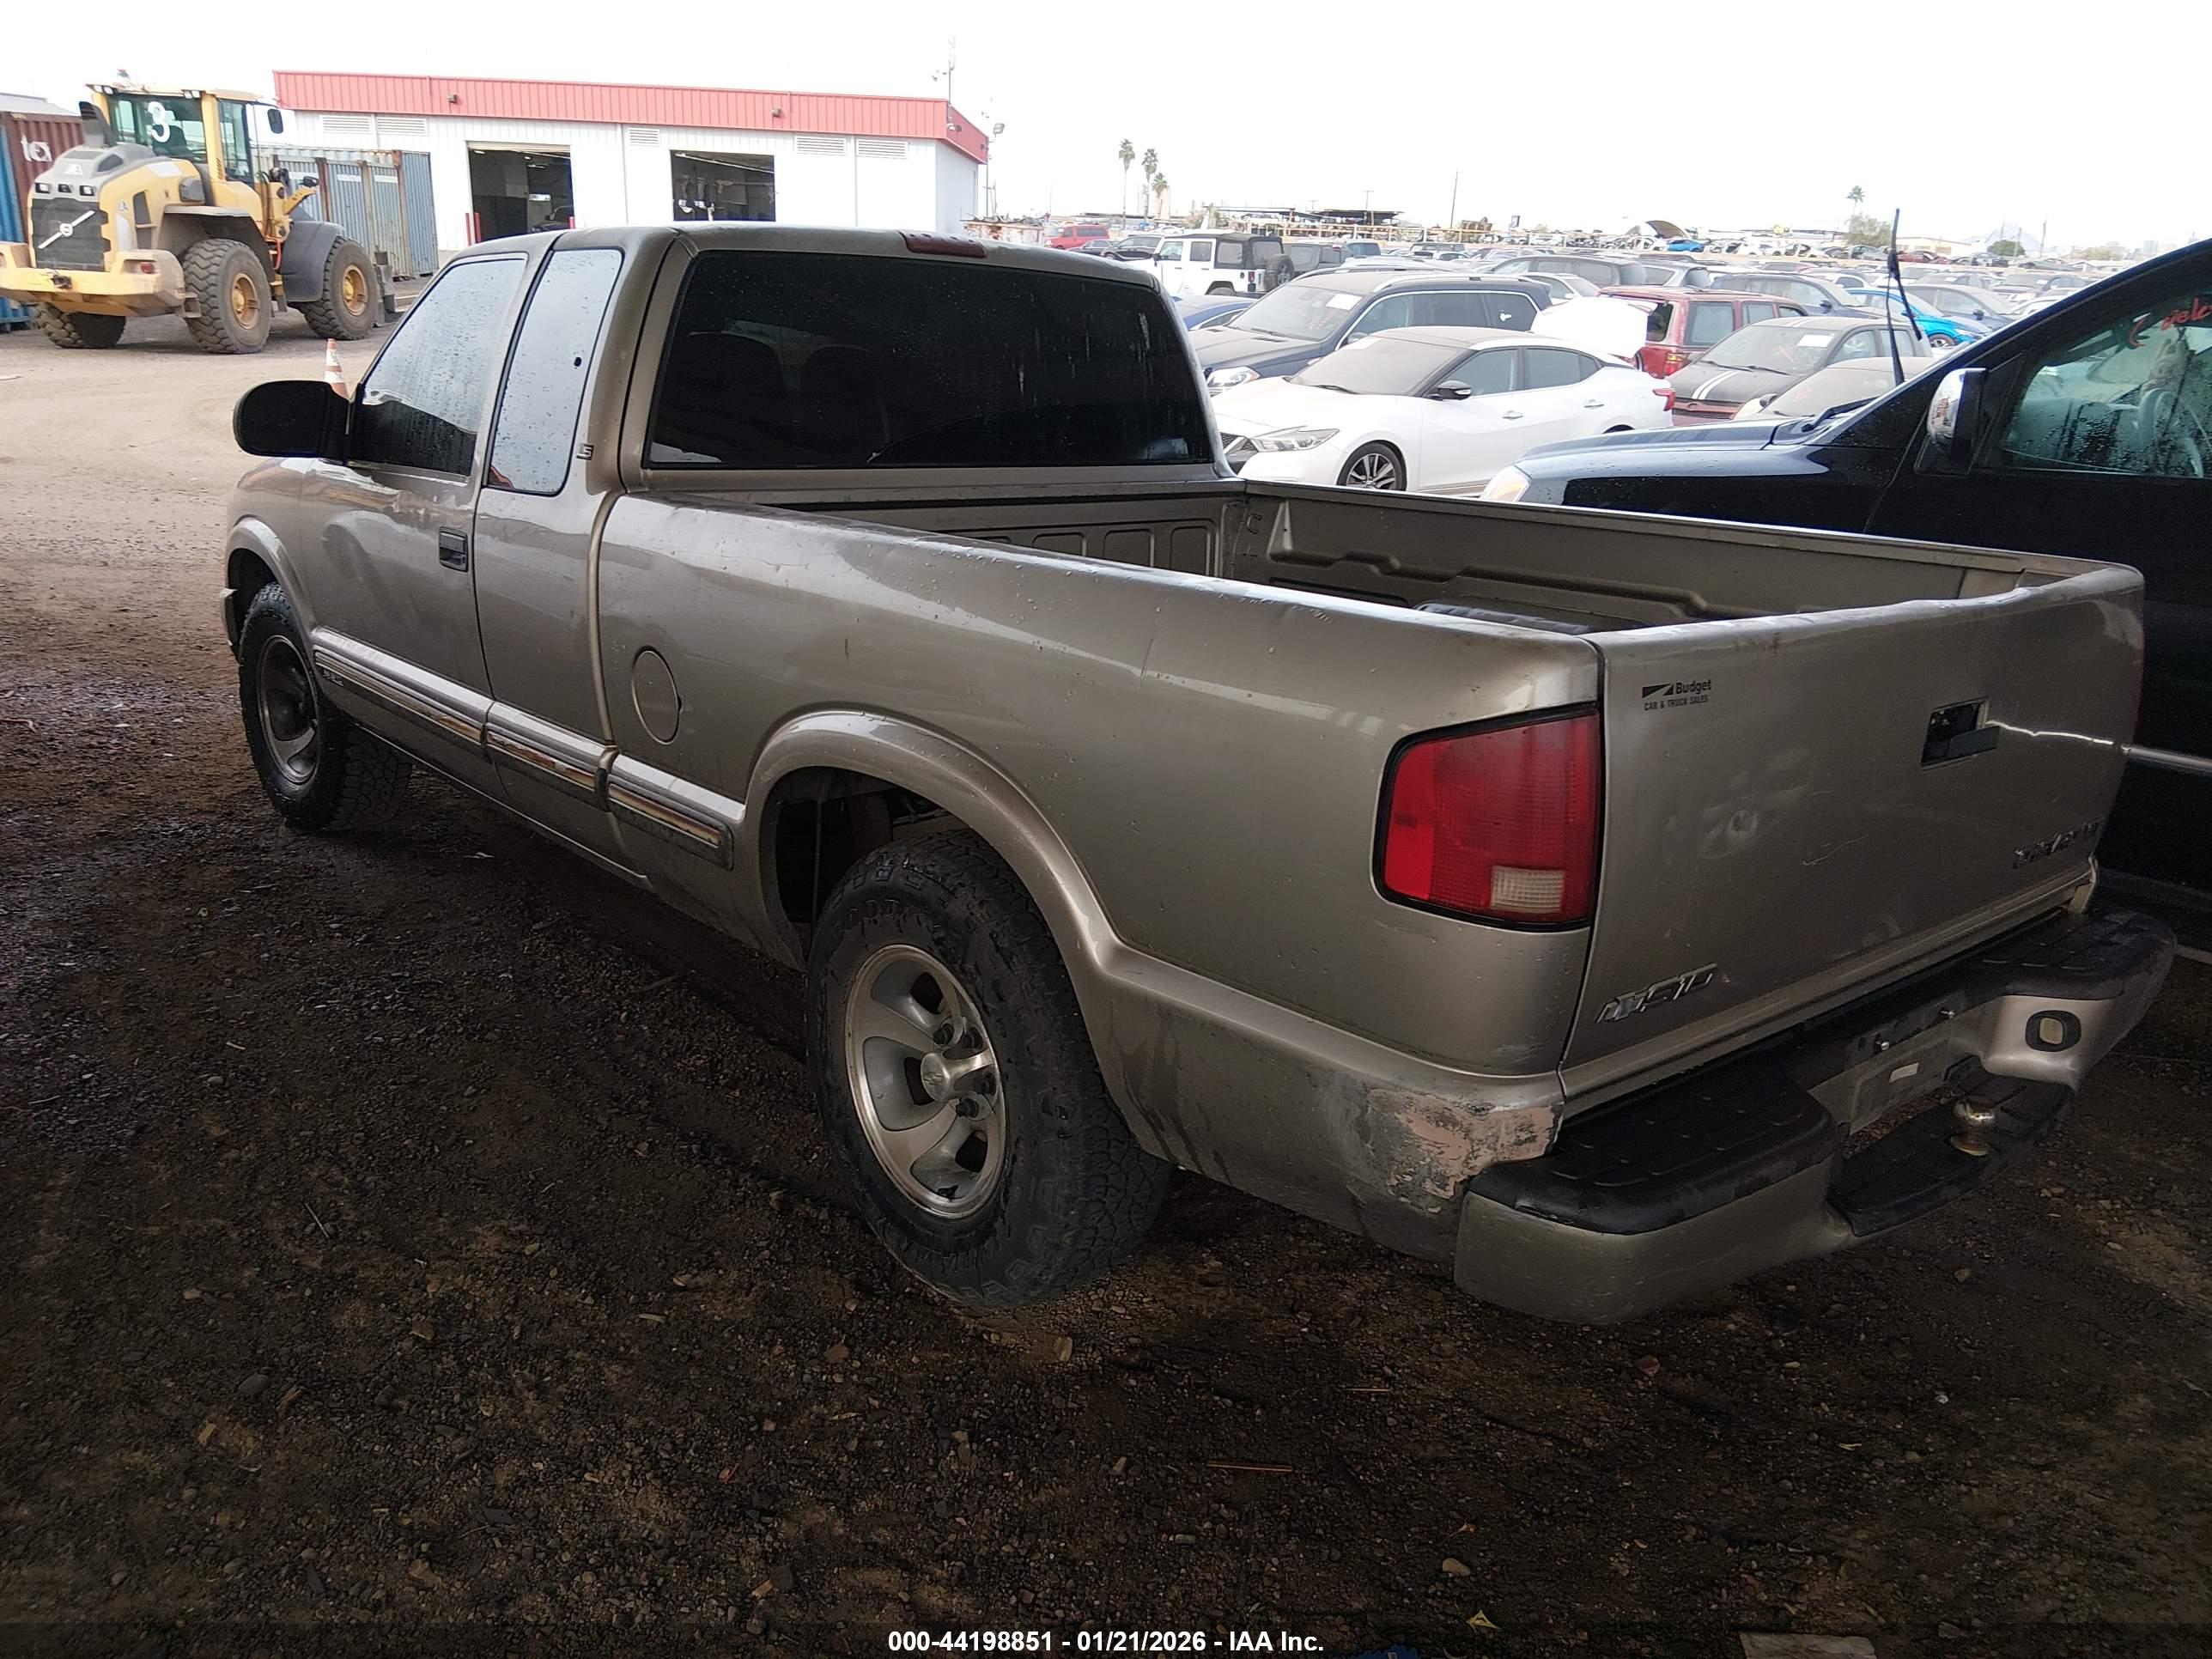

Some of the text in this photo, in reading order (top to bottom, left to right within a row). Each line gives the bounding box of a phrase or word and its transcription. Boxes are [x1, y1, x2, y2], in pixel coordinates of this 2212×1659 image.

[147, 100, 171, 143] 3
[1675, 679, 1711, 695] Budget
[1644, 701, 1657, 711] CAR
[1668, 697, 1687, 708] TRUCK
[1689, 695, 1709, 705] SALES
